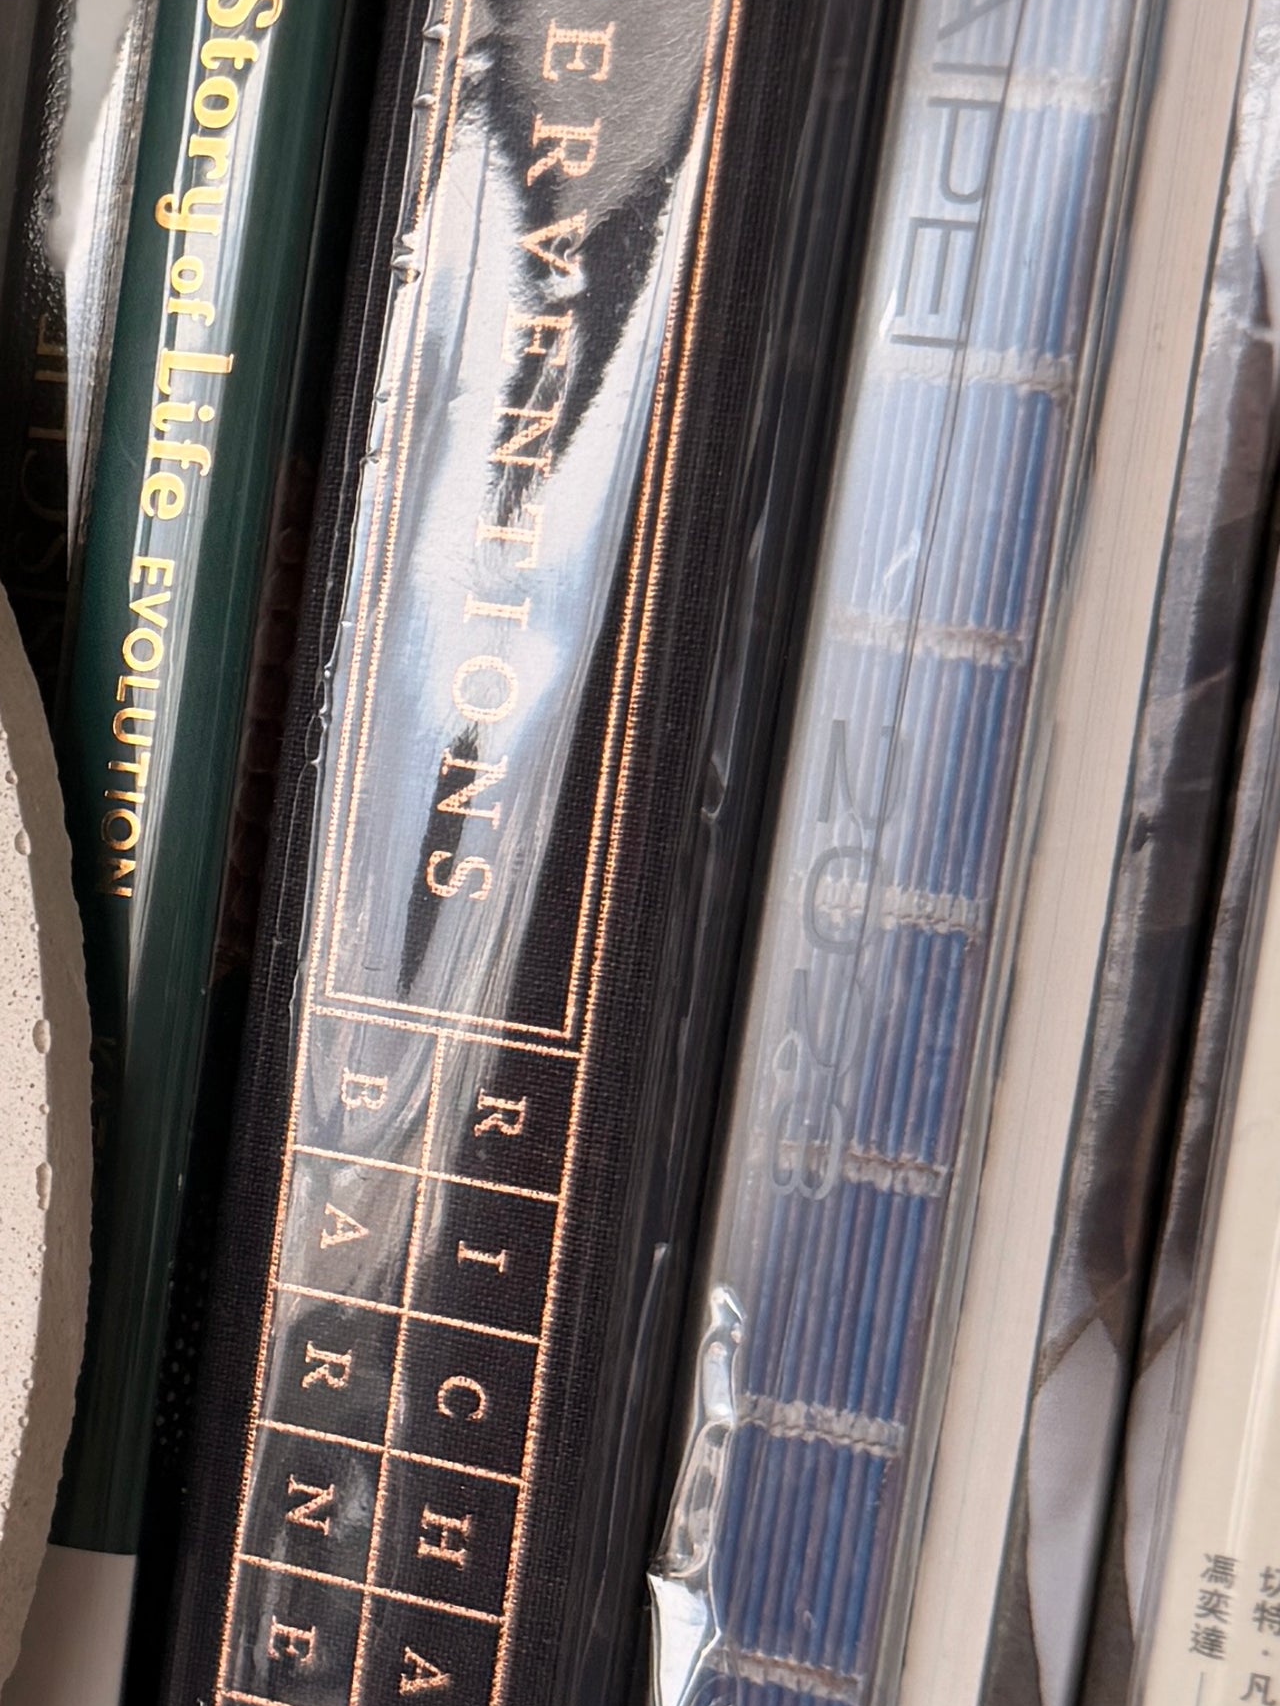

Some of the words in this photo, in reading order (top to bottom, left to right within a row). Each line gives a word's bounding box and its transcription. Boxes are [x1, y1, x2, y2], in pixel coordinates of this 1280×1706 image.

[167, 253, 216, 329] of
[141, 346, 235, 522] Life
[100, 553, 174, 899] EVOLUTION
